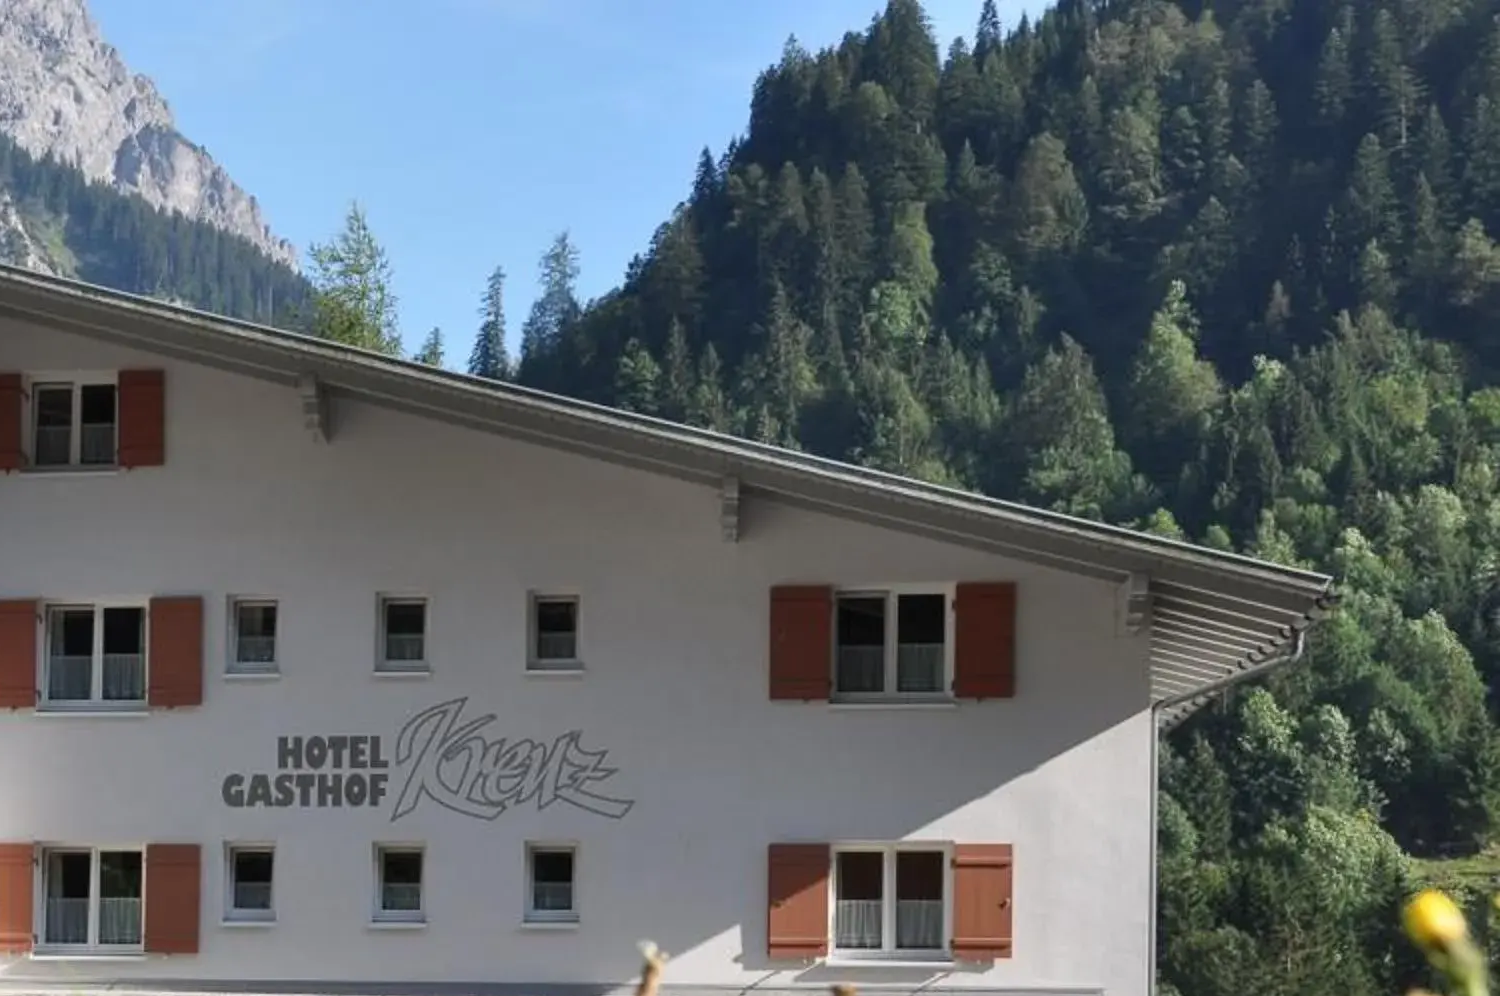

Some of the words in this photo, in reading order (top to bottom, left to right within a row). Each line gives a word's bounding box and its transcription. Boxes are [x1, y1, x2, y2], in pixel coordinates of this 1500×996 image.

[277, 736, 389, 769] HOTEL
[390, 696, 635, 822] Kreuz
[221, 773, 388, 808] GASTHOF
